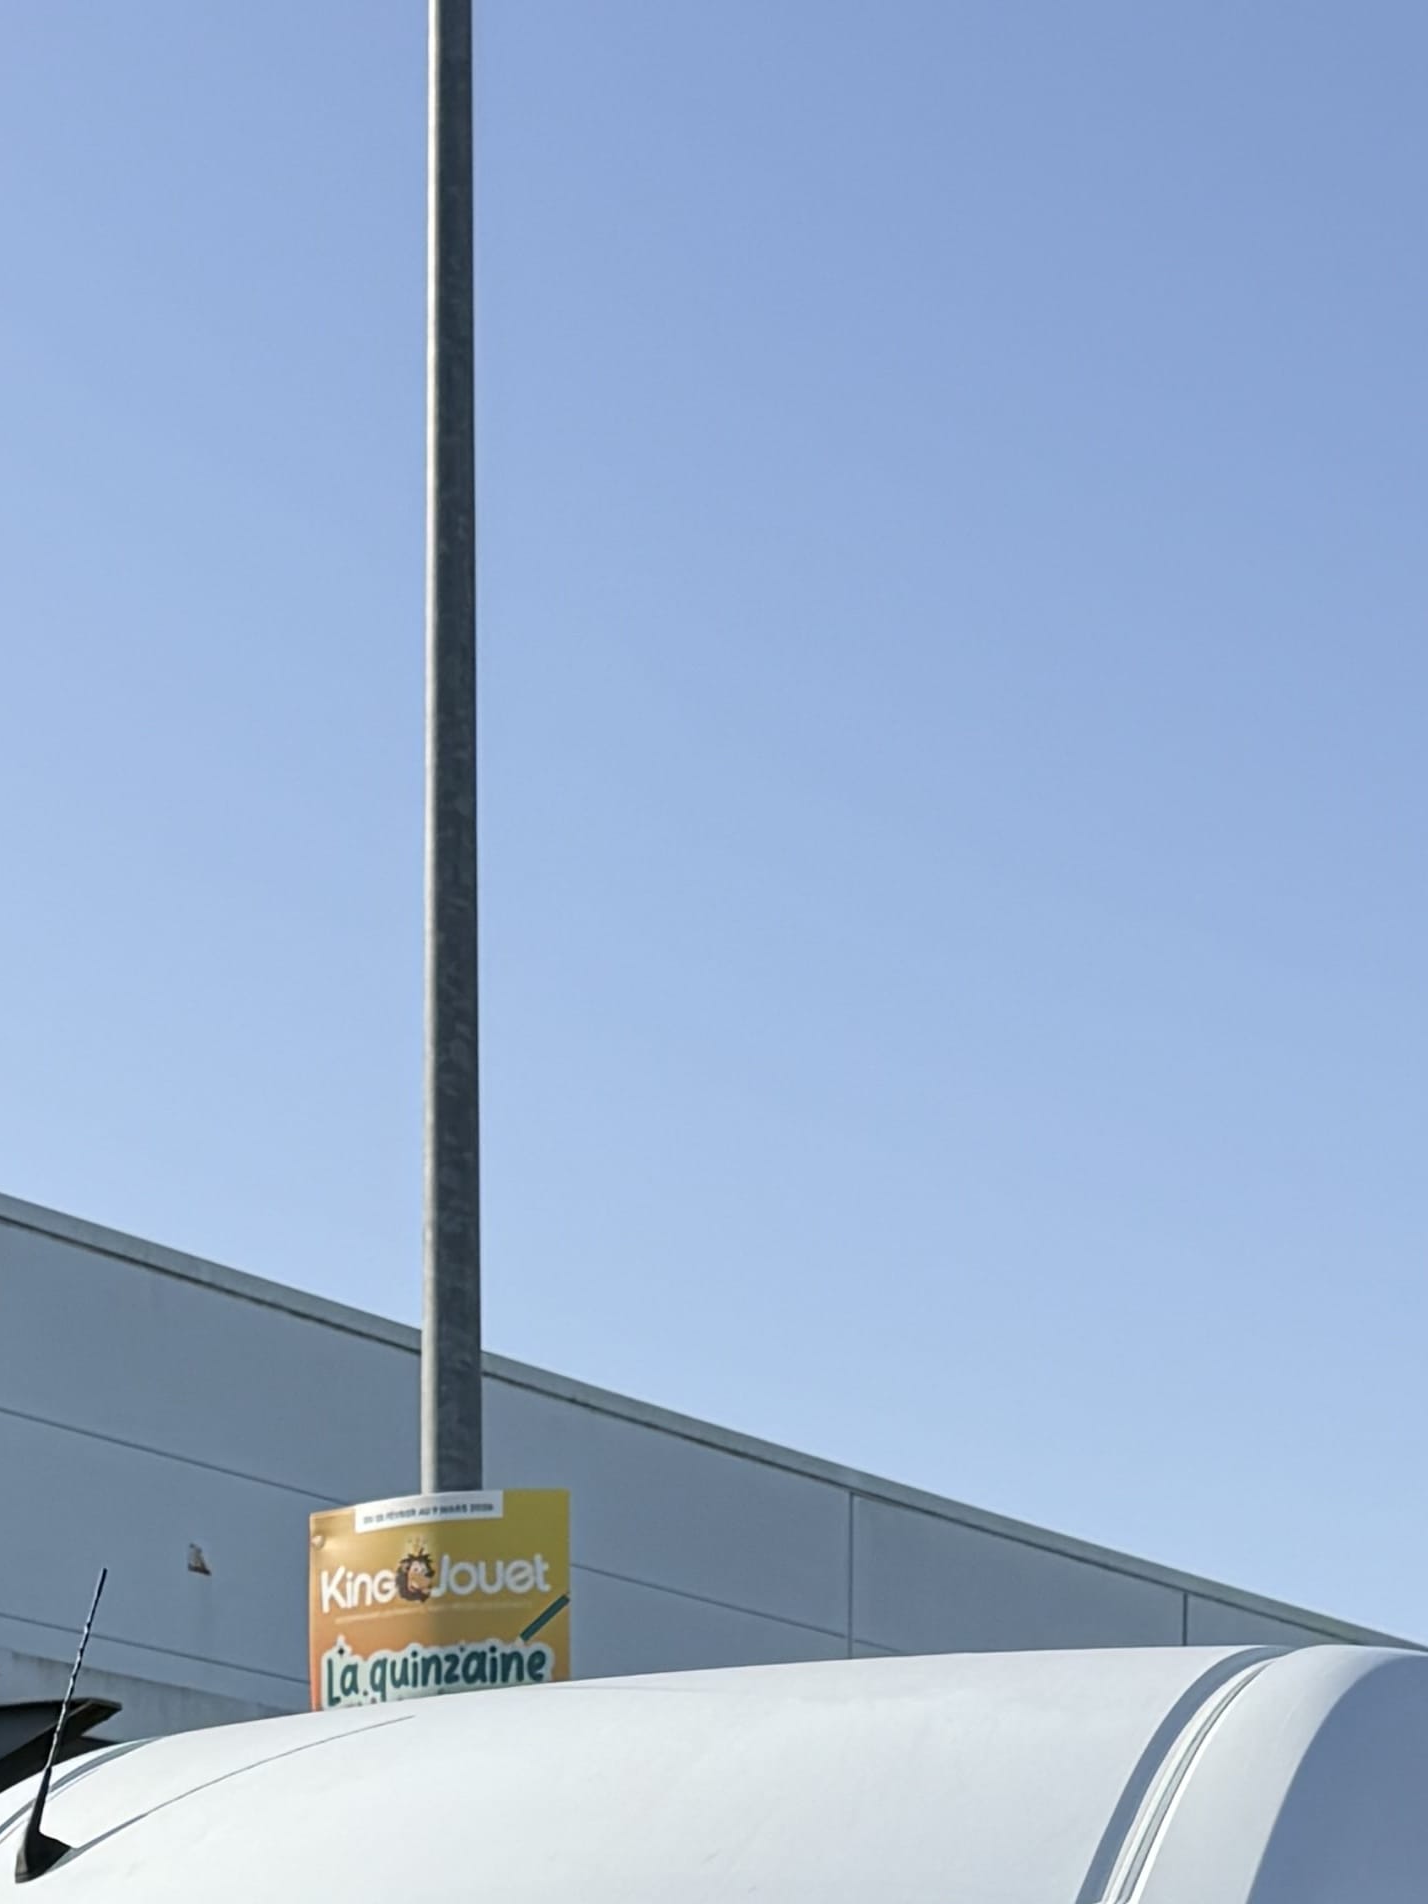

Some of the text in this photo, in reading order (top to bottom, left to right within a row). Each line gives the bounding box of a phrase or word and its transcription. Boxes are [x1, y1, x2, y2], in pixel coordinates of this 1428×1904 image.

[430, 1553, 551, 1599] Jouet
[328, 1646, 547, 1706] La quinzaine
